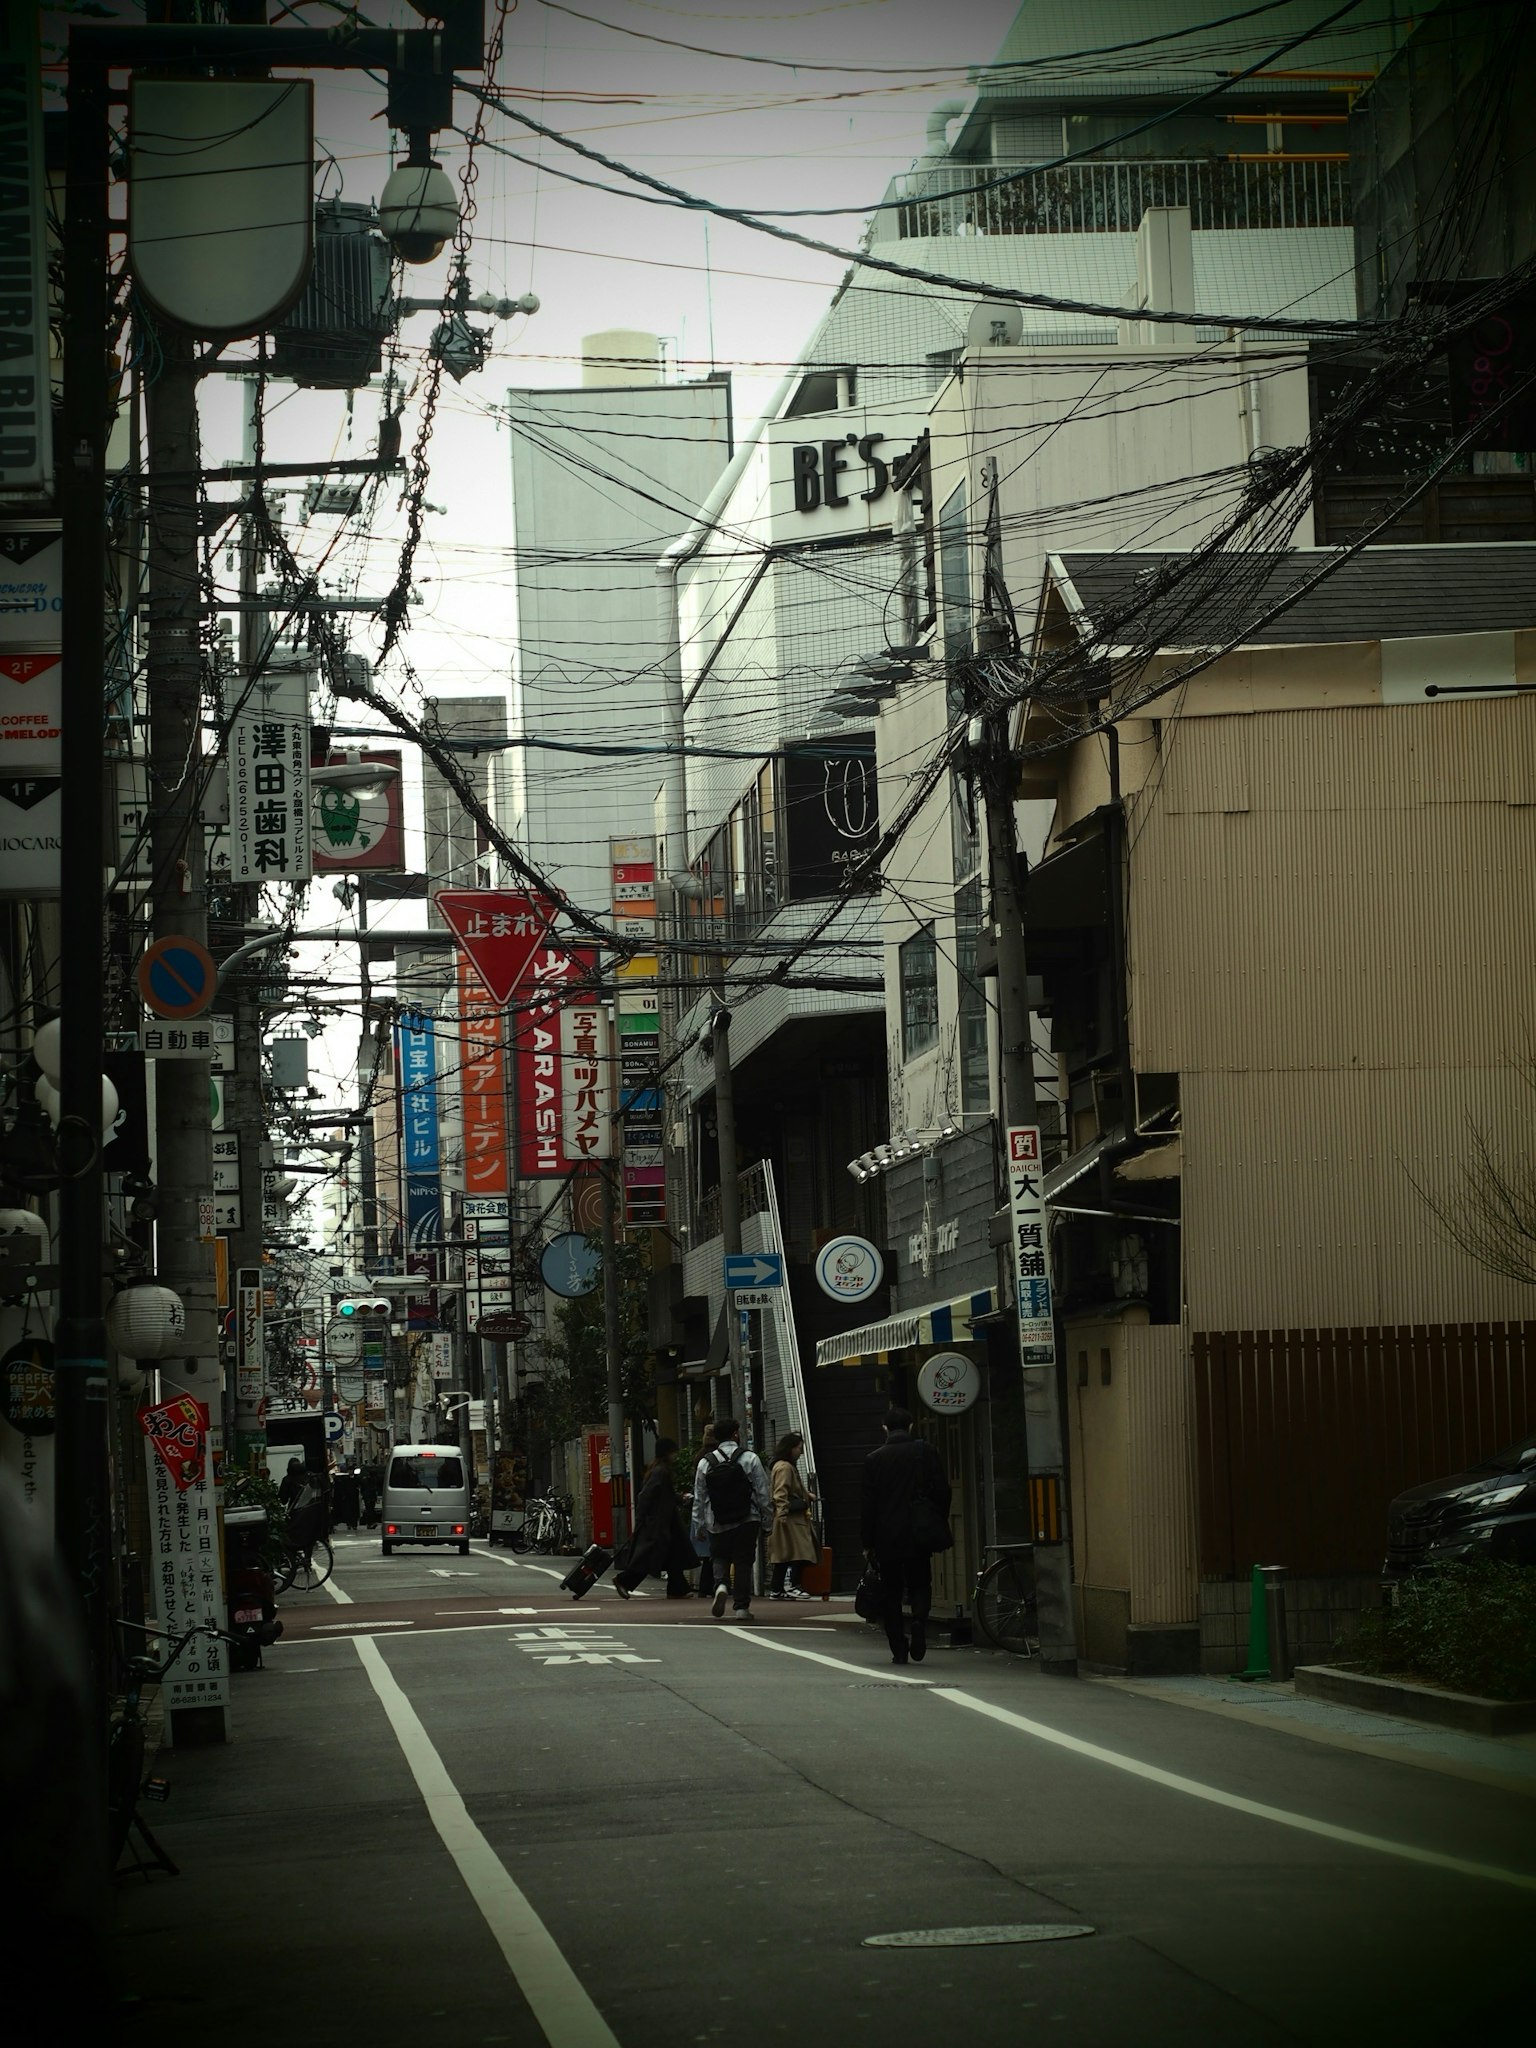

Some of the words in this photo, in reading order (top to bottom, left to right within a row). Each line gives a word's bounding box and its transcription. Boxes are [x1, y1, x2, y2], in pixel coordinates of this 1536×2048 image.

[793, 433, 889, 512] BE'S
[5, 537, 30, 551] 3F
[12, 662, 33, 675] 2F
[1, 715, 48, 725] COFFEE
[12, 782, 36, 797] 1F
[253, 724, 289, 874] 澤田歯科
[617, 869, 624, 880] 5
[465, 912, 541, 938] 止まれ
[145, 1031, 211, 1052] 自動車
[573, 1011, 605, 1158] 写真のツバメヤ
[532, 1027, 558, 1170] ARASHI
[1014, 1134, 1034, 1158] 質
[1010, 1164, 1041, 1173] DAIICHI
[409, 1187, 439, 1196] NIPPO
[465, 1201, 508, 1215] 浪花会館
[1014, 1174, 1045, 1277] 大一質舗
[736, 1293, 774, 1306] 自転車を除く
[325, 1414, 343, 1438] P
